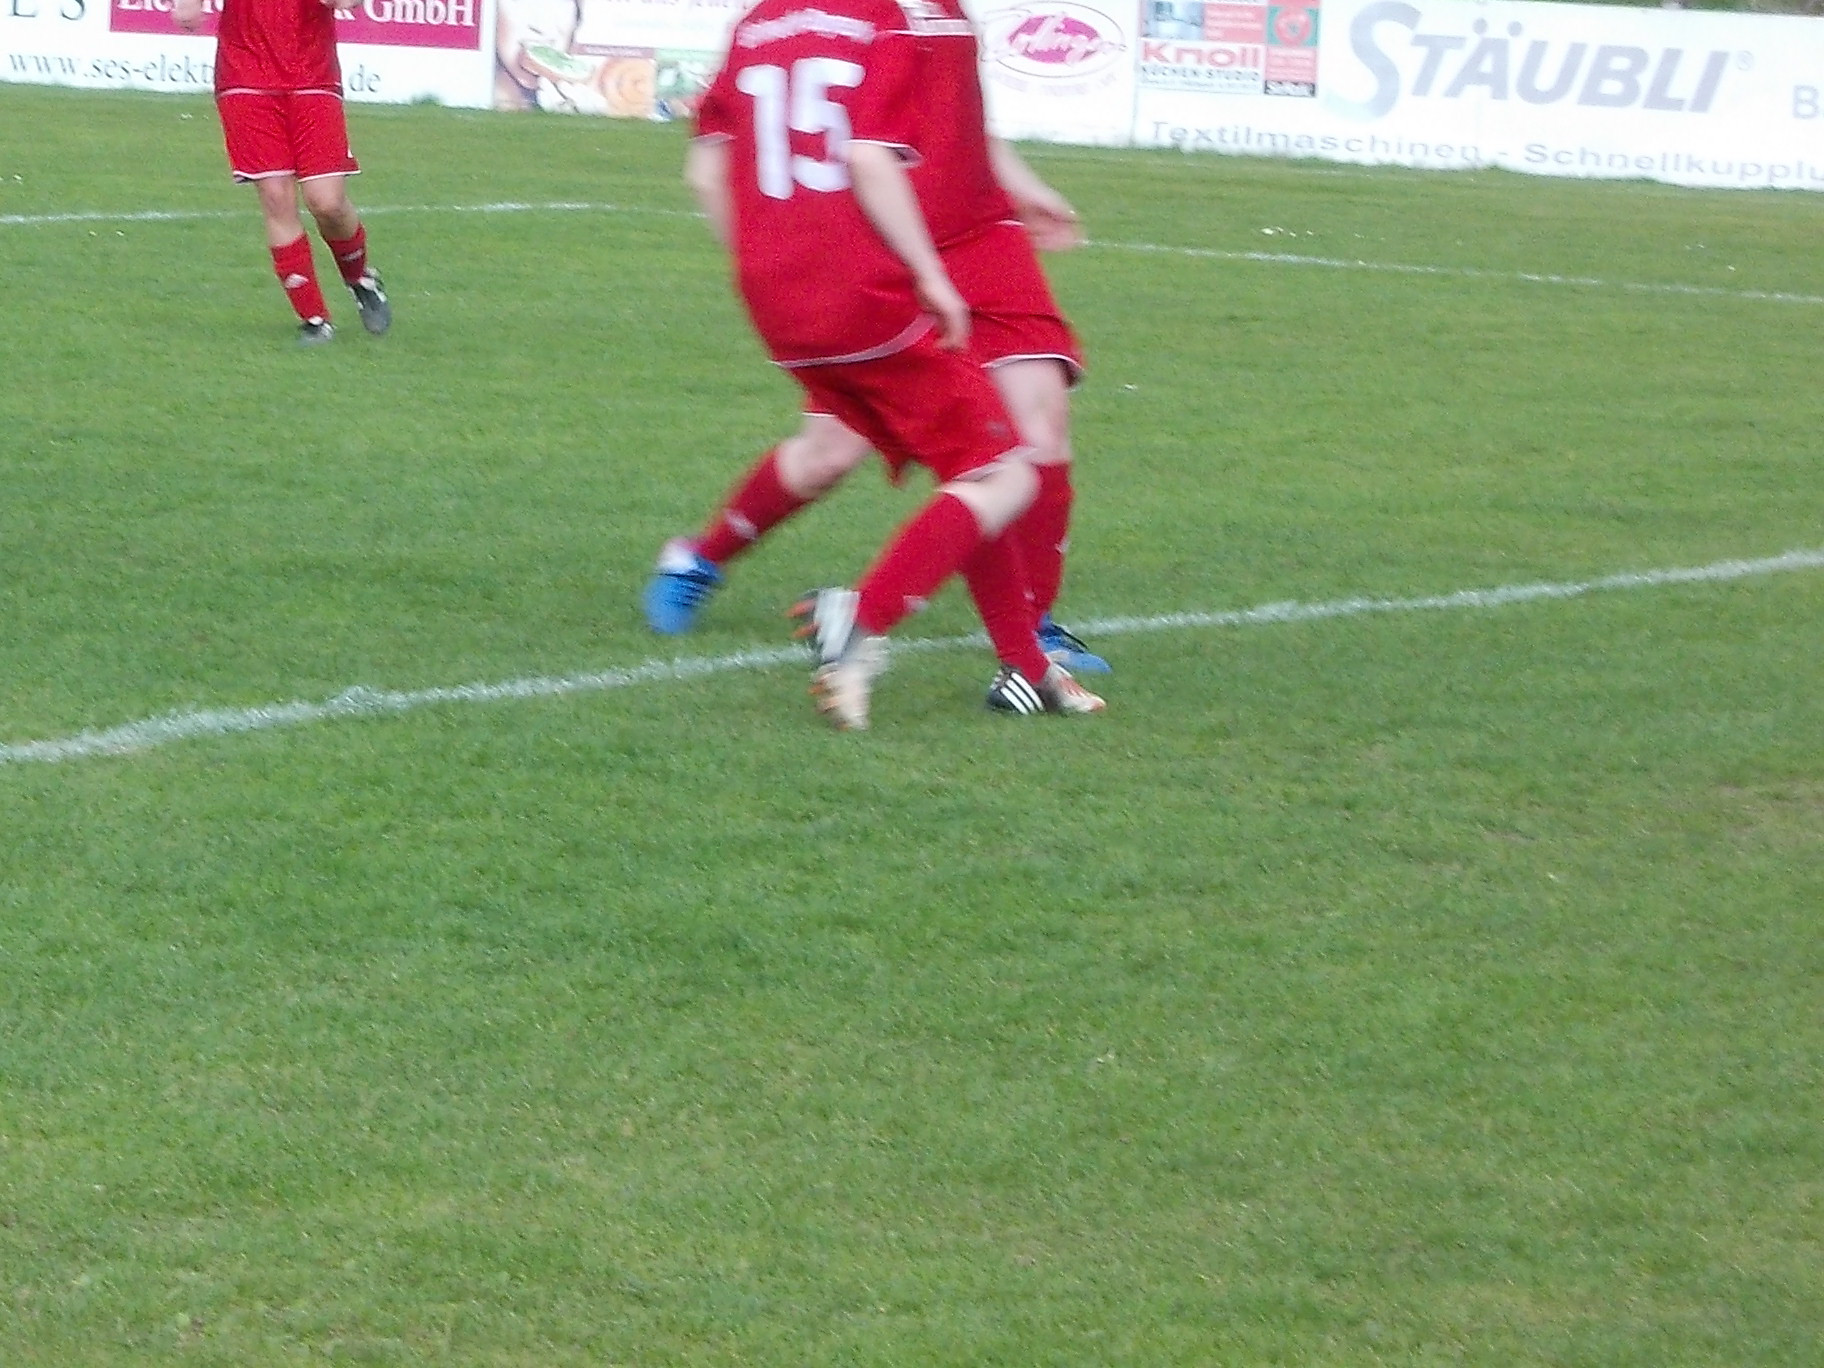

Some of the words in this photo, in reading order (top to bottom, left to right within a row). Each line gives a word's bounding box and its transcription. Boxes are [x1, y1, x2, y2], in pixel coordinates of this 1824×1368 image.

[1141, 41, 1259, 68] Knoll
[1322, 0, 1730, 123] STÄUBLI
[735, 56, 866, 200] 15
[1151, 120, 1479, 162] Textilmaschinen
[1523, 142, 1824, 184] Schnellkupplu
